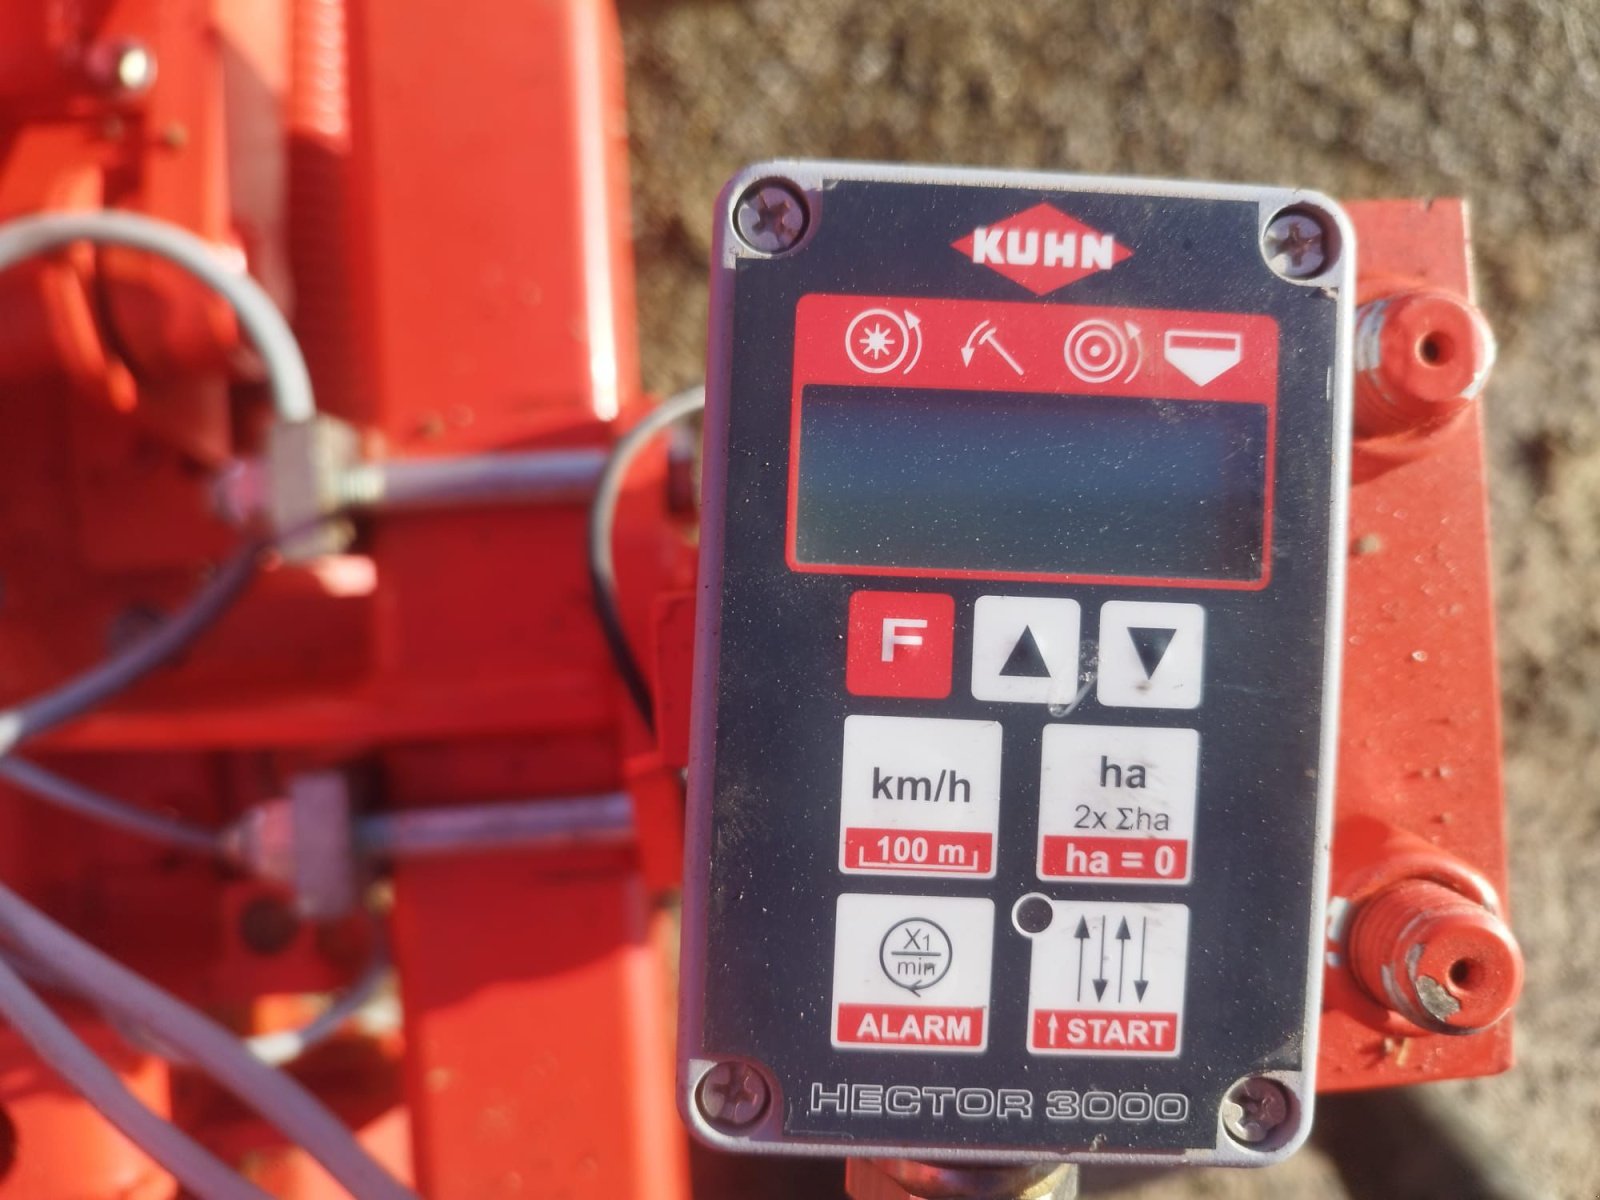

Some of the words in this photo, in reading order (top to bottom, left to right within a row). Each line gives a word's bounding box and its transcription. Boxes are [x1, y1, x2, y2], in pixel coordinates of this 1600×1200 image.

[971, 226, 1114, 270] KUHN
[881, 618, 928, 663] F
[871, 767, 971, 803] km/h
[1100, 755, 1146, 789] ha
[1073, 804, 1107, 830] 2x
[877, 835, 929, 863] 100
[939, 842, 966, 865] m
[1066, 843, 1110, 875] ha
[1154, 846, 1176, 876] 0
[896, 958, 936, 977] min
[856, 1013, 971, 1042] ALARM
[1066, 1018, 1169, 1046] START
[810, 1083, 1034, 1120] HECTOR
[1045, 1090, 1190, 1123] 3000
